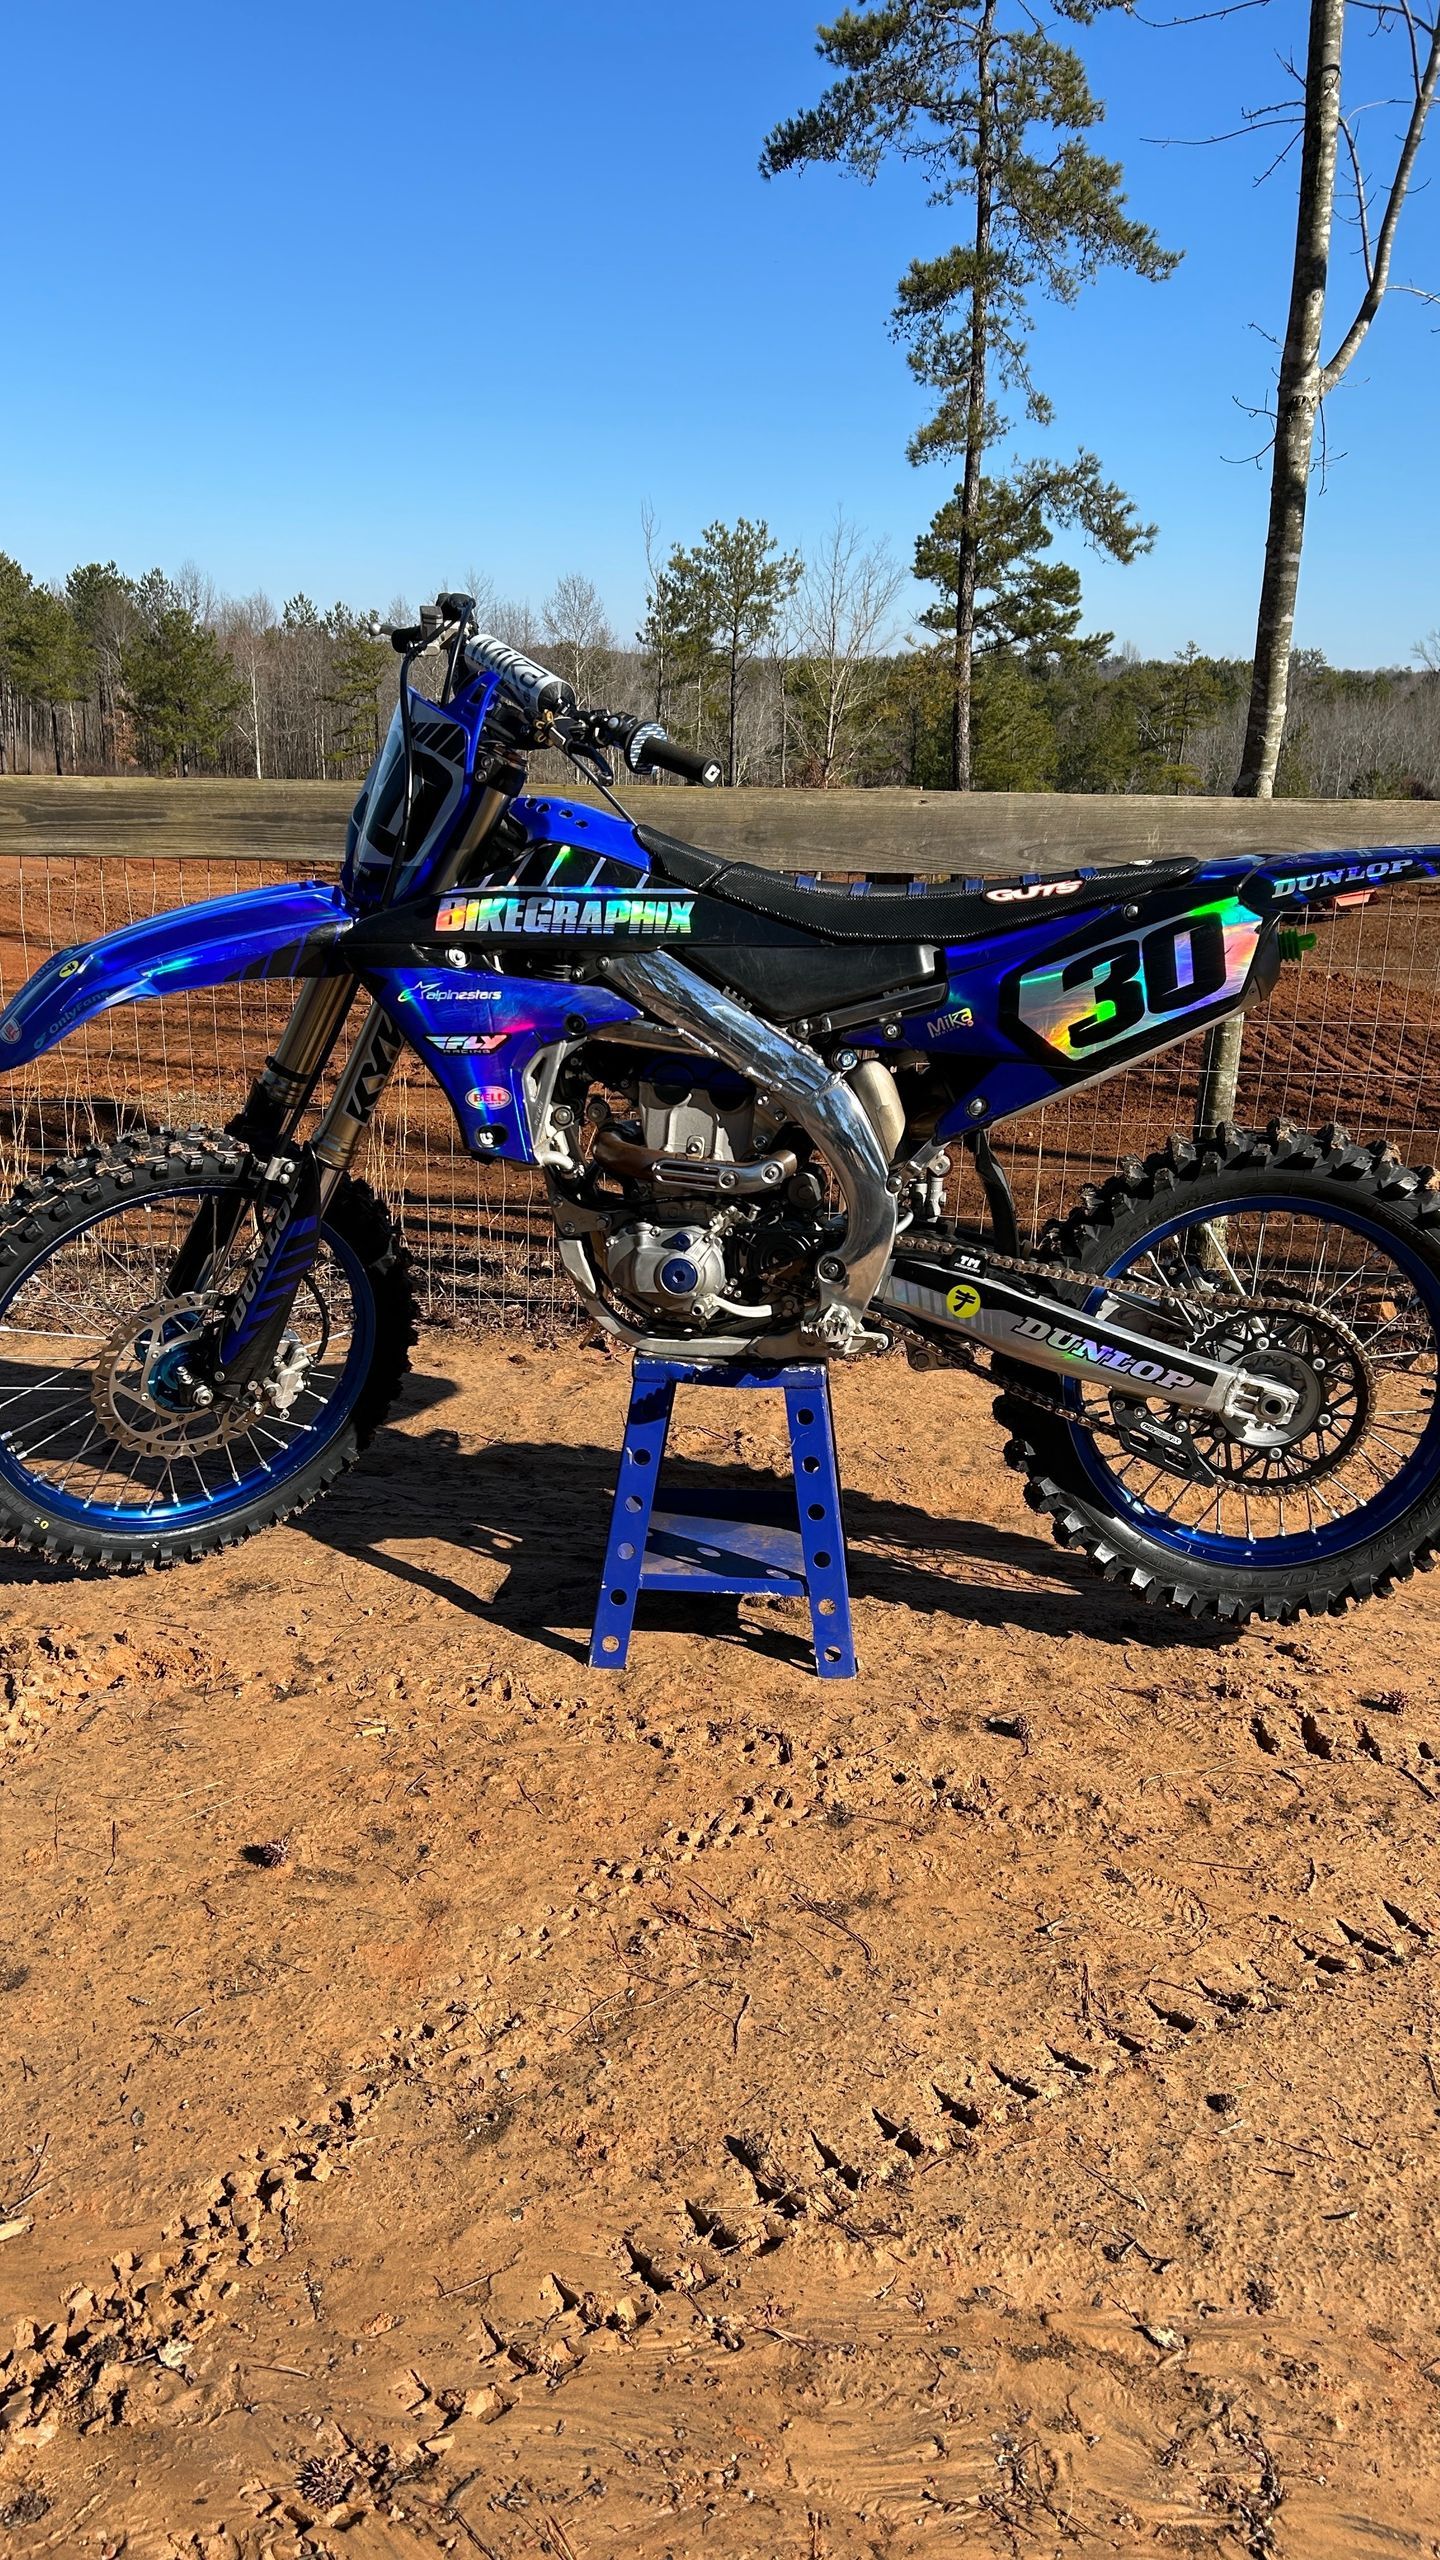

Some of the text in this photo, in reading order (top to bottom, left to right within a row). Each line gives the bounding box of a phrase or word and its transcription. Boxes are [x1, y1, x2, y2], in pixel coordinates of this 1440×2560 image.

[986, 880, 1083, 902] GUTS
[1271, 859, 1413, 899] DUNLOP
[435, 897, 695, 934] BIKEGRAPHIX
[1062, 912, 1226, 1049] 30
[426, 989, 502, 1002] alpinestars
[49, 990, 110, 1034] OnlyFans
[426, 1034, 508, 1050] FLY
[473, 1092, 505, 1103] BELL
[960, 1255, 981, 1269] TM
[1011, 1316, 1195, 1390] DUNLOP
